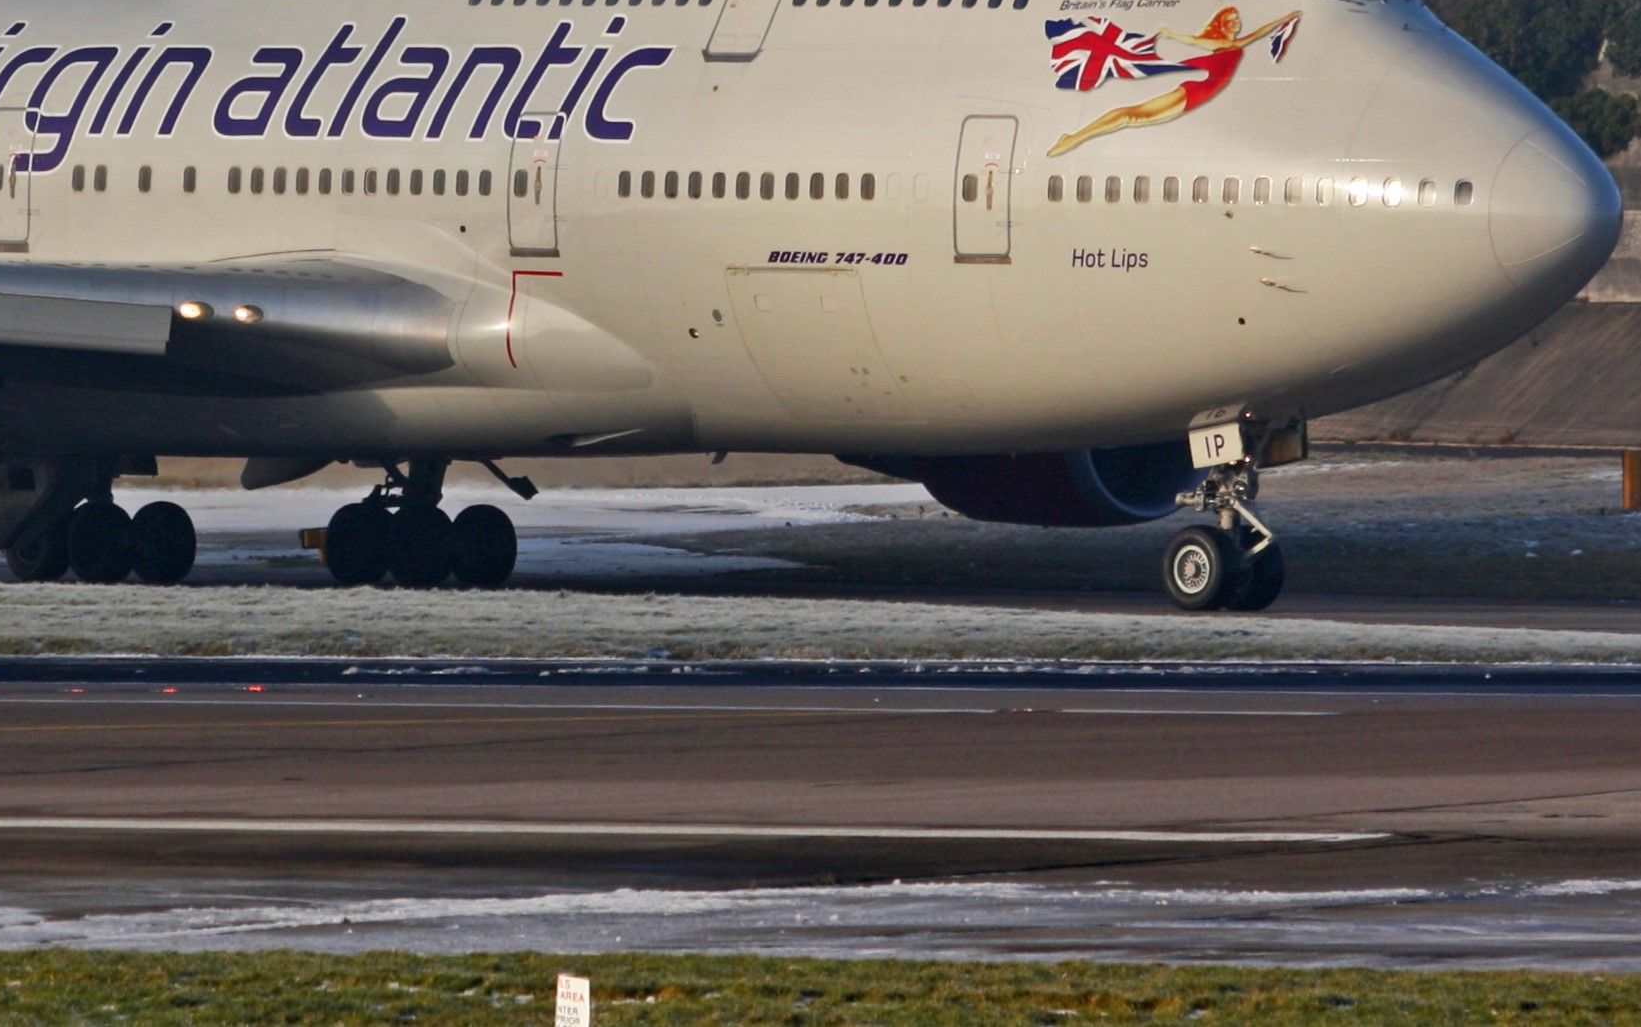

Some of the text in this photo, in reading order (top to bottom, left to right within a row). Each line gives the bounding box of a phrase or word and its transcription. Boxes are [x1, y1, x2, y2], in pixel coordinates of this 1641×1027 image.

[212, 15, 674, 141] atlantic
[768, 251, 908, 265] BOEING 747-400
[1072, 248, 1148, 273] Hot Lips
[1204, 434, 1225, 459] IP
